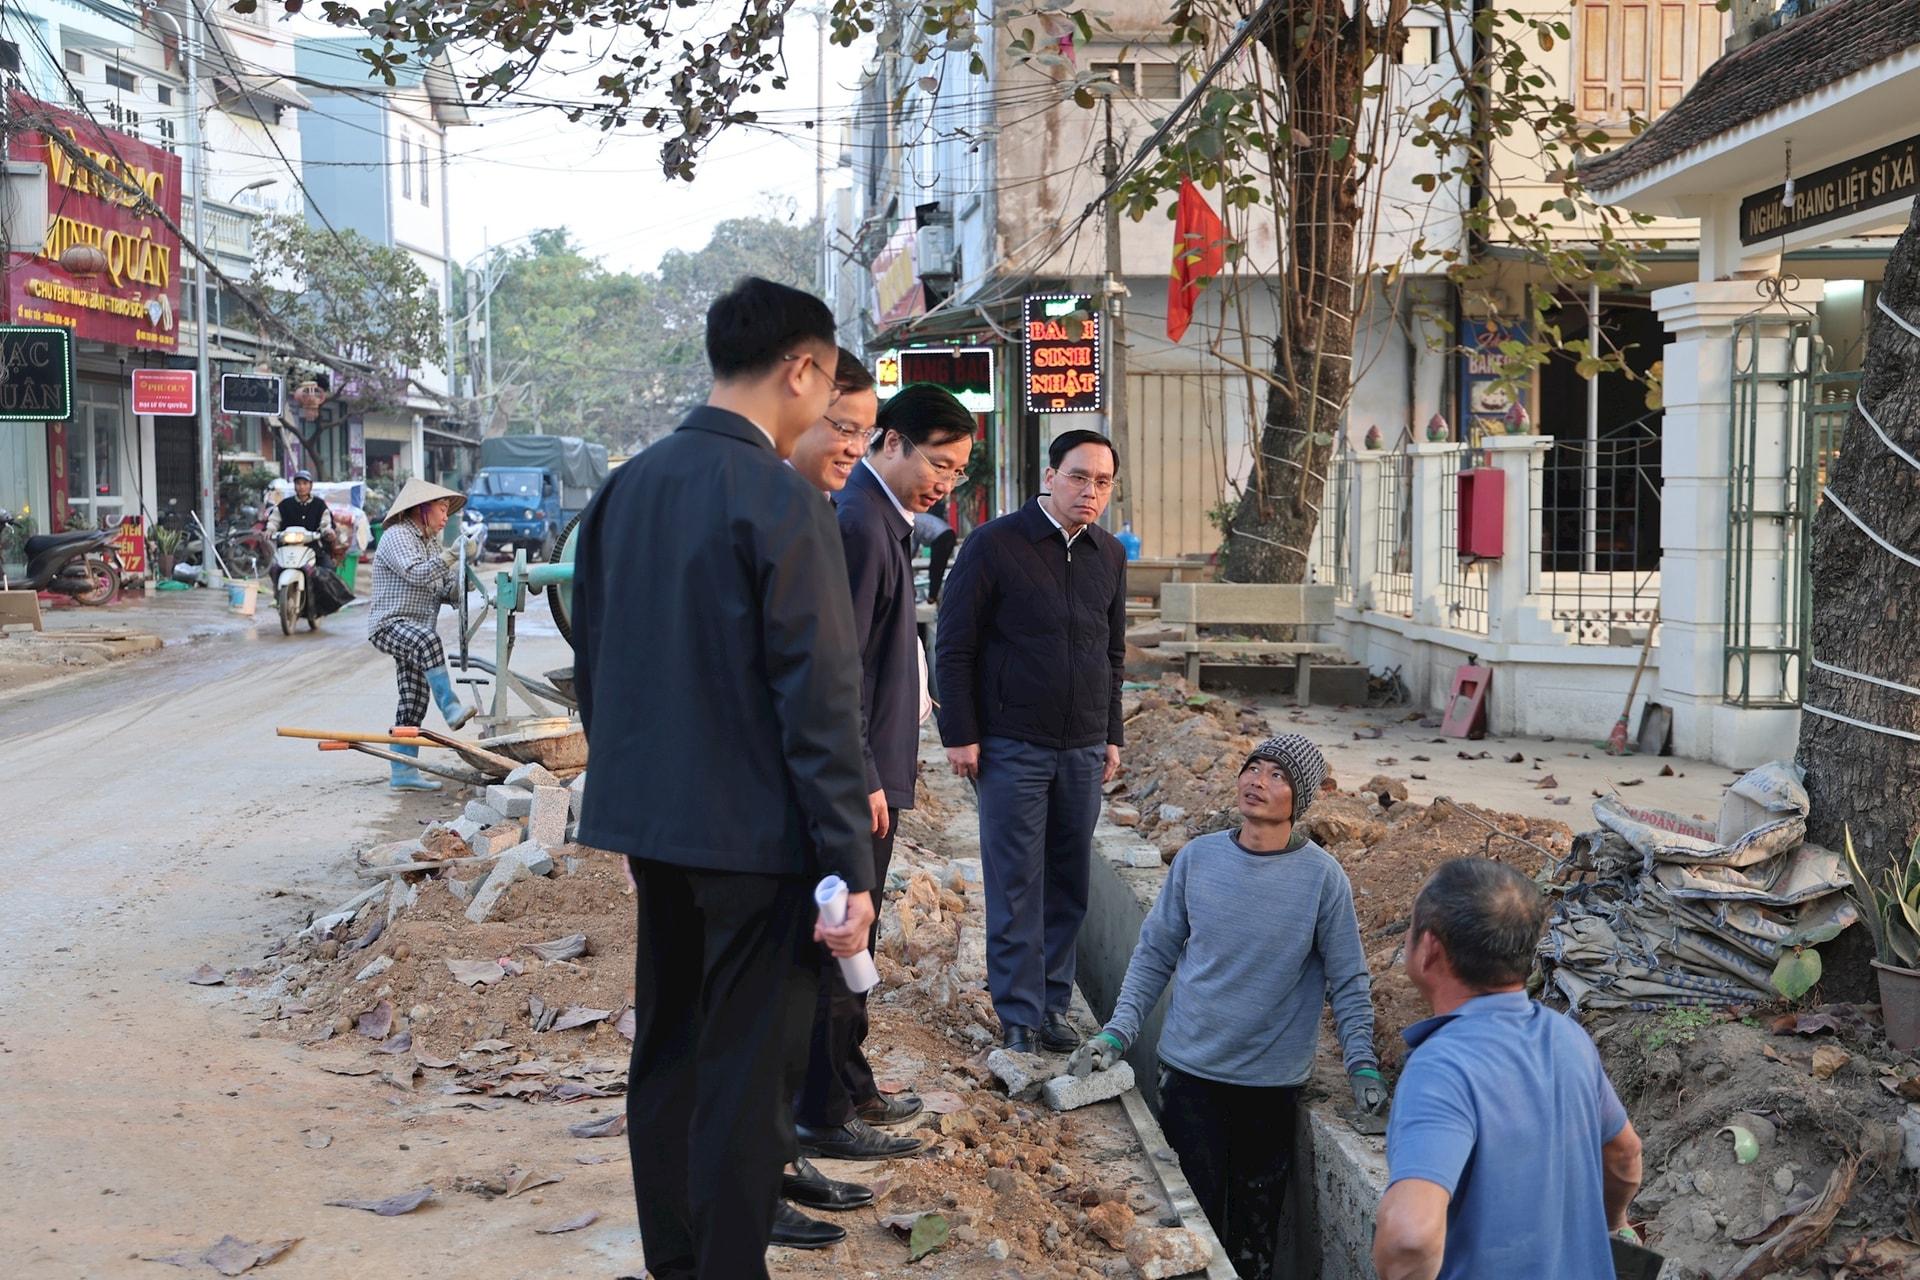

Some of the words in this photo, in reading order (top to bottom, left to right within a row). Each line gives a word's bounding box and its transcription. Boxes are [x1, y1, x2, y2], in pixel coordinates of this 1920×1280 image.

[1750, 193, 1788, 236] NGHĨA
[1790, 183, 1834, 223] TRANG
[1838, 166, 1867, 211] LIỆT
[1871, 154, 1890, 197] SĨ
[1891, 146, 1915, 191] XÃ
[104, 226, 171, 288] QUÂN
[1035, 347, 1091, 367] SINH
[1031, 369, 1095, 397] NHẬT
